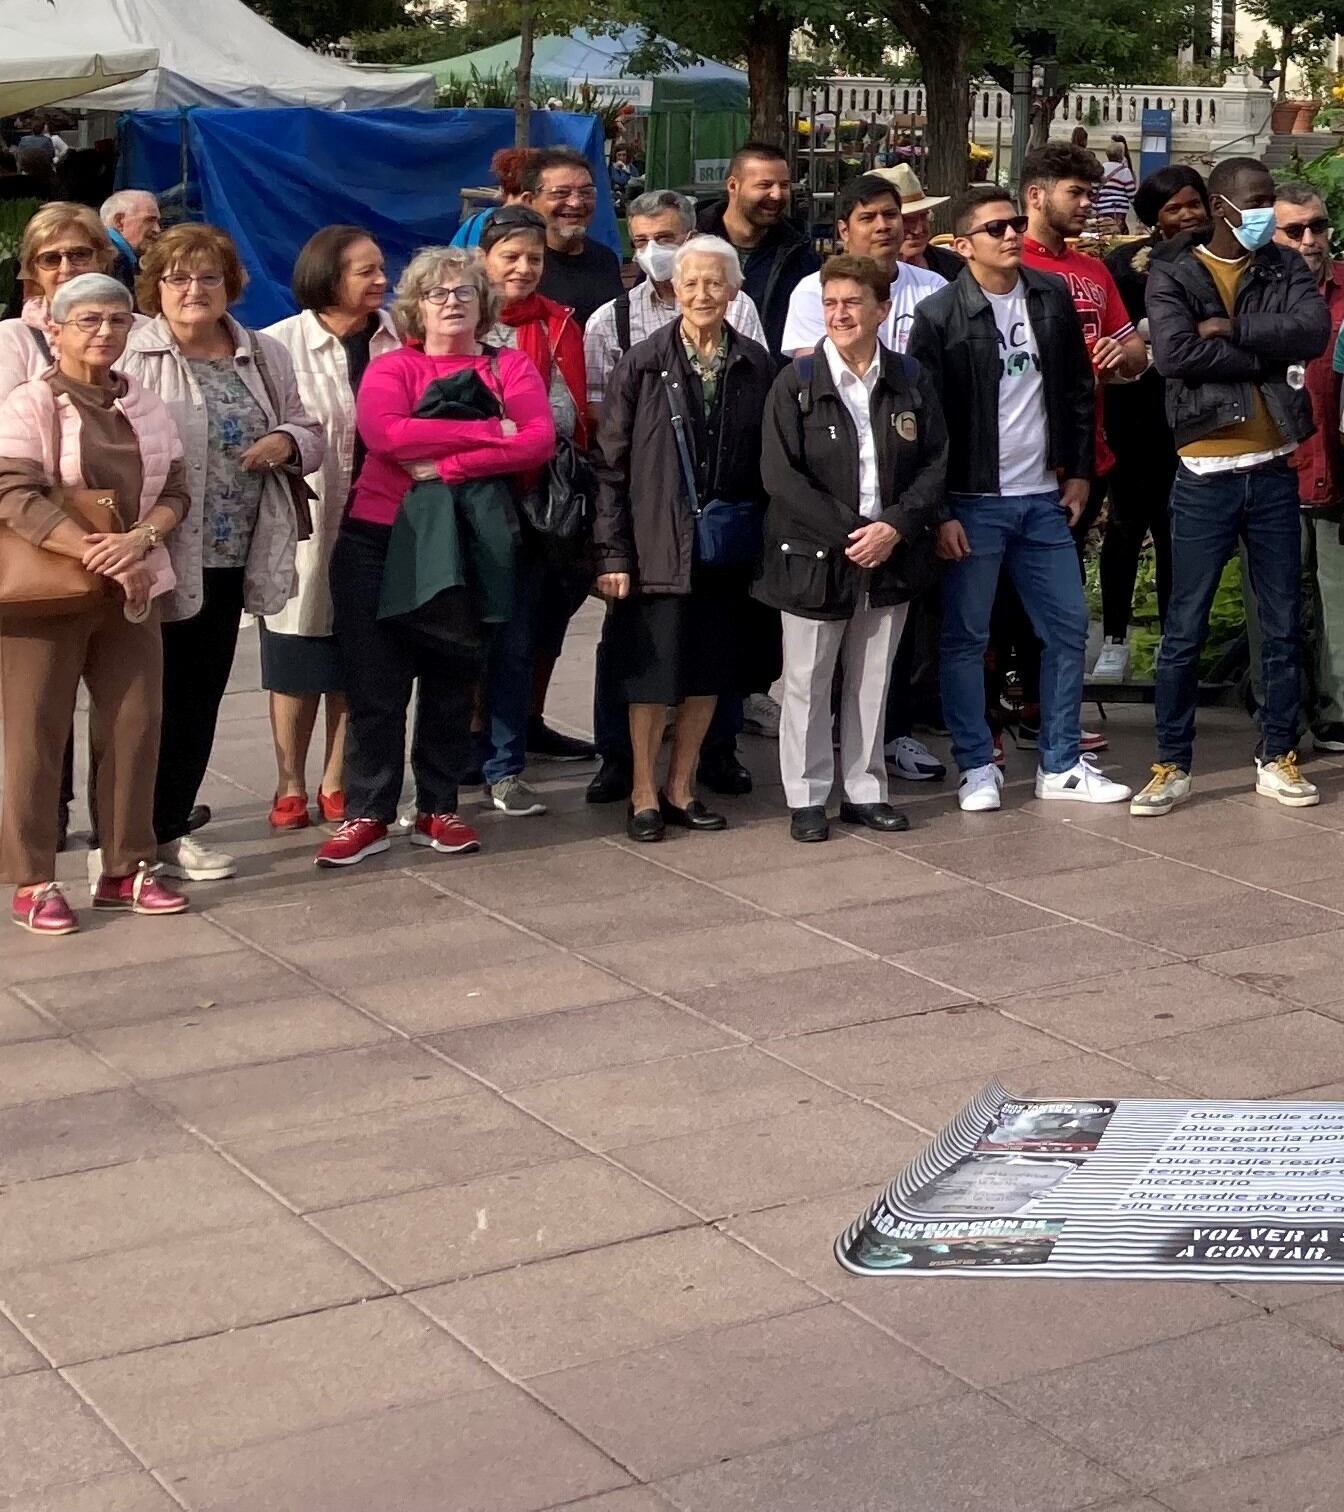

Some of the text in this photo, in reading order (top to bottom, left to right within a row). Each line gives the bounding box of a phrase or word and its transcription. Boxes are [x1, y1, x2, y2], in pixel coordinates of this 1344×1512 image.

[1191, 1112, 1234, 1120] Que
[1181, 1124, 1225, 1132] Que
[1232, 1124, 1293, 1132] nadie
[1173, 1134, 1301, 1143] emergencia
[1165, 1144, 1301, 1153] al necesario
[1156, 1157, 1201, 1165] Que
[1209, 1158, 1272, 1166] nadie
[1148, 1168, 1276, 1177] temporales
[1139, 1178, 1250, 1186] necesario
[1129, 1192, 1176, 1200] Que
[1184, 1192, 1248, 1200] nadie
[1120, 1202, 1151, 1210] sin
[1160, 1202, 1287, 1212] alternativa
[1296, 1203, 1324, 1212] de
[1310, 1230, 1329, 1242] A
[1176, 1245, 1195, 1258] A
[1204, 1245, 1332, 1261] CONTAR,
